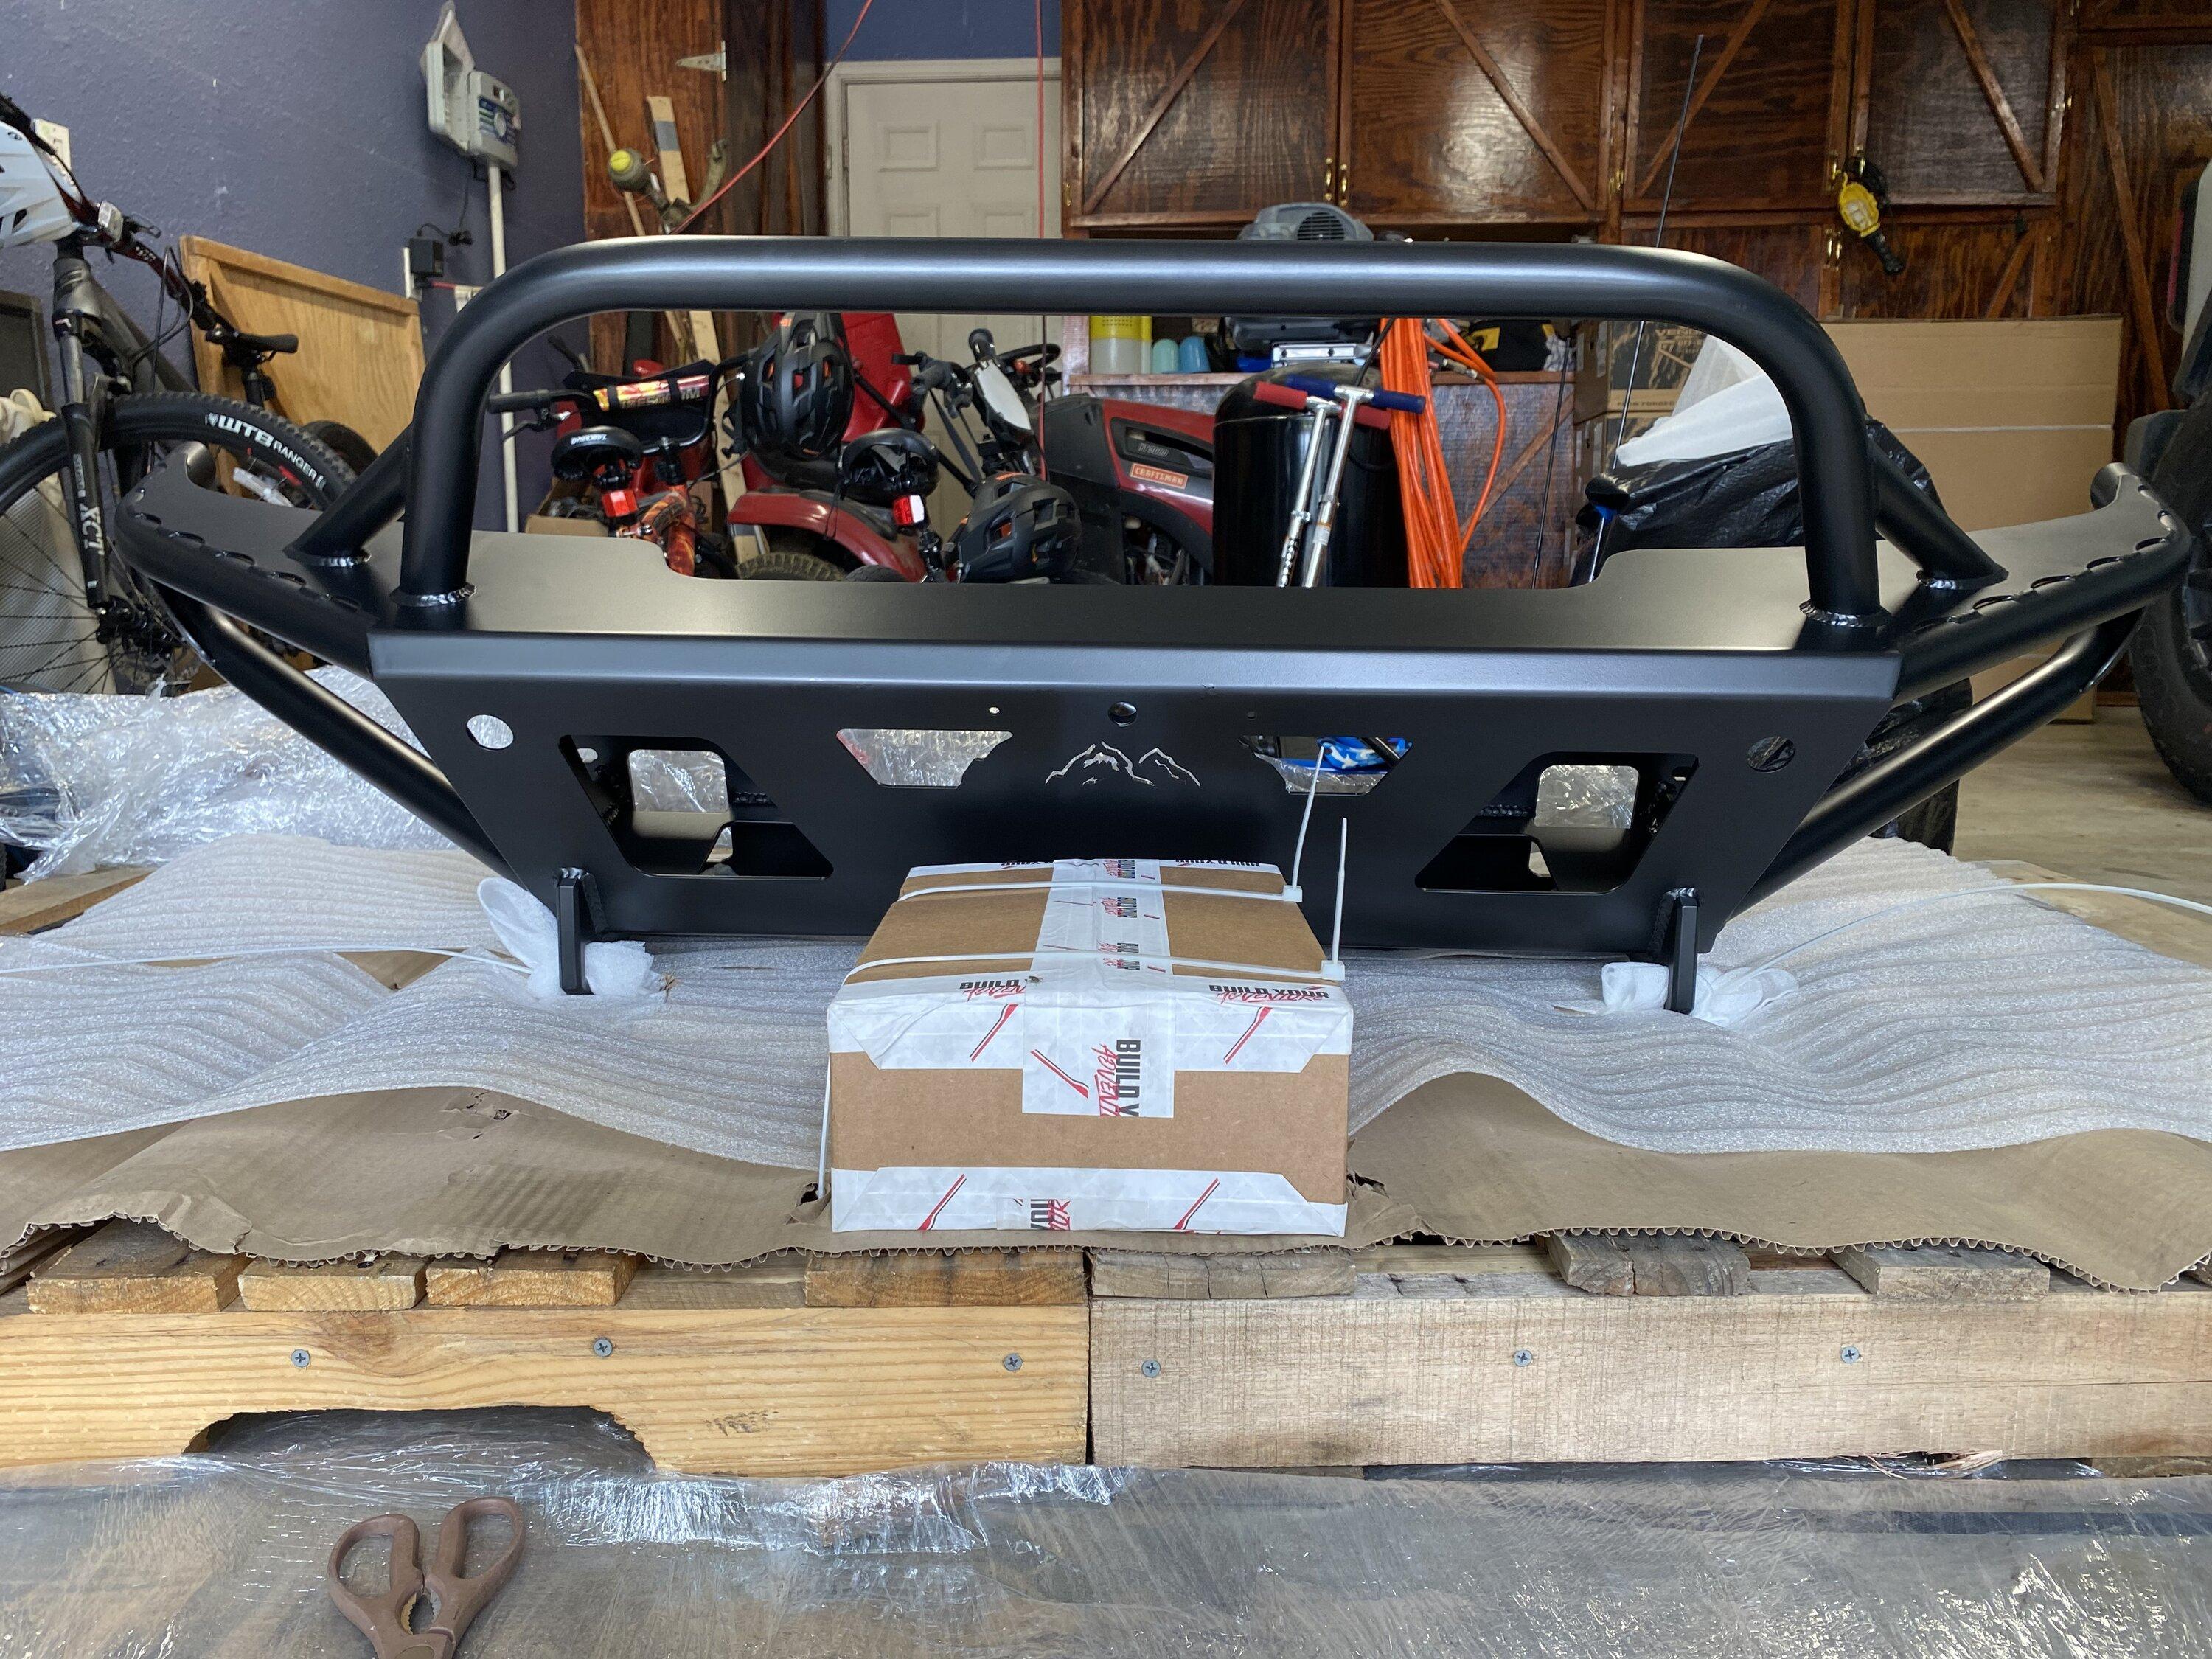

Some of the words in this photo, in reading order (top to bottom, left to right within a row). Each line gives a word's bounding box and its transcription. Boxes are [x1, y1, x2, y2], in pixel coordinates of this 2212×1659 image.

[273, 440, 317, 481] RANGER
[1135, 467, 1184, 486] CRAFTSMAN
[959, 979, 1020, 990] BUILD
[1209, 984, 1268, 995] BUILD
[1272, 988, 1331, 999] YOUR
[1116, 1039, 1141, 1098] BUILD
